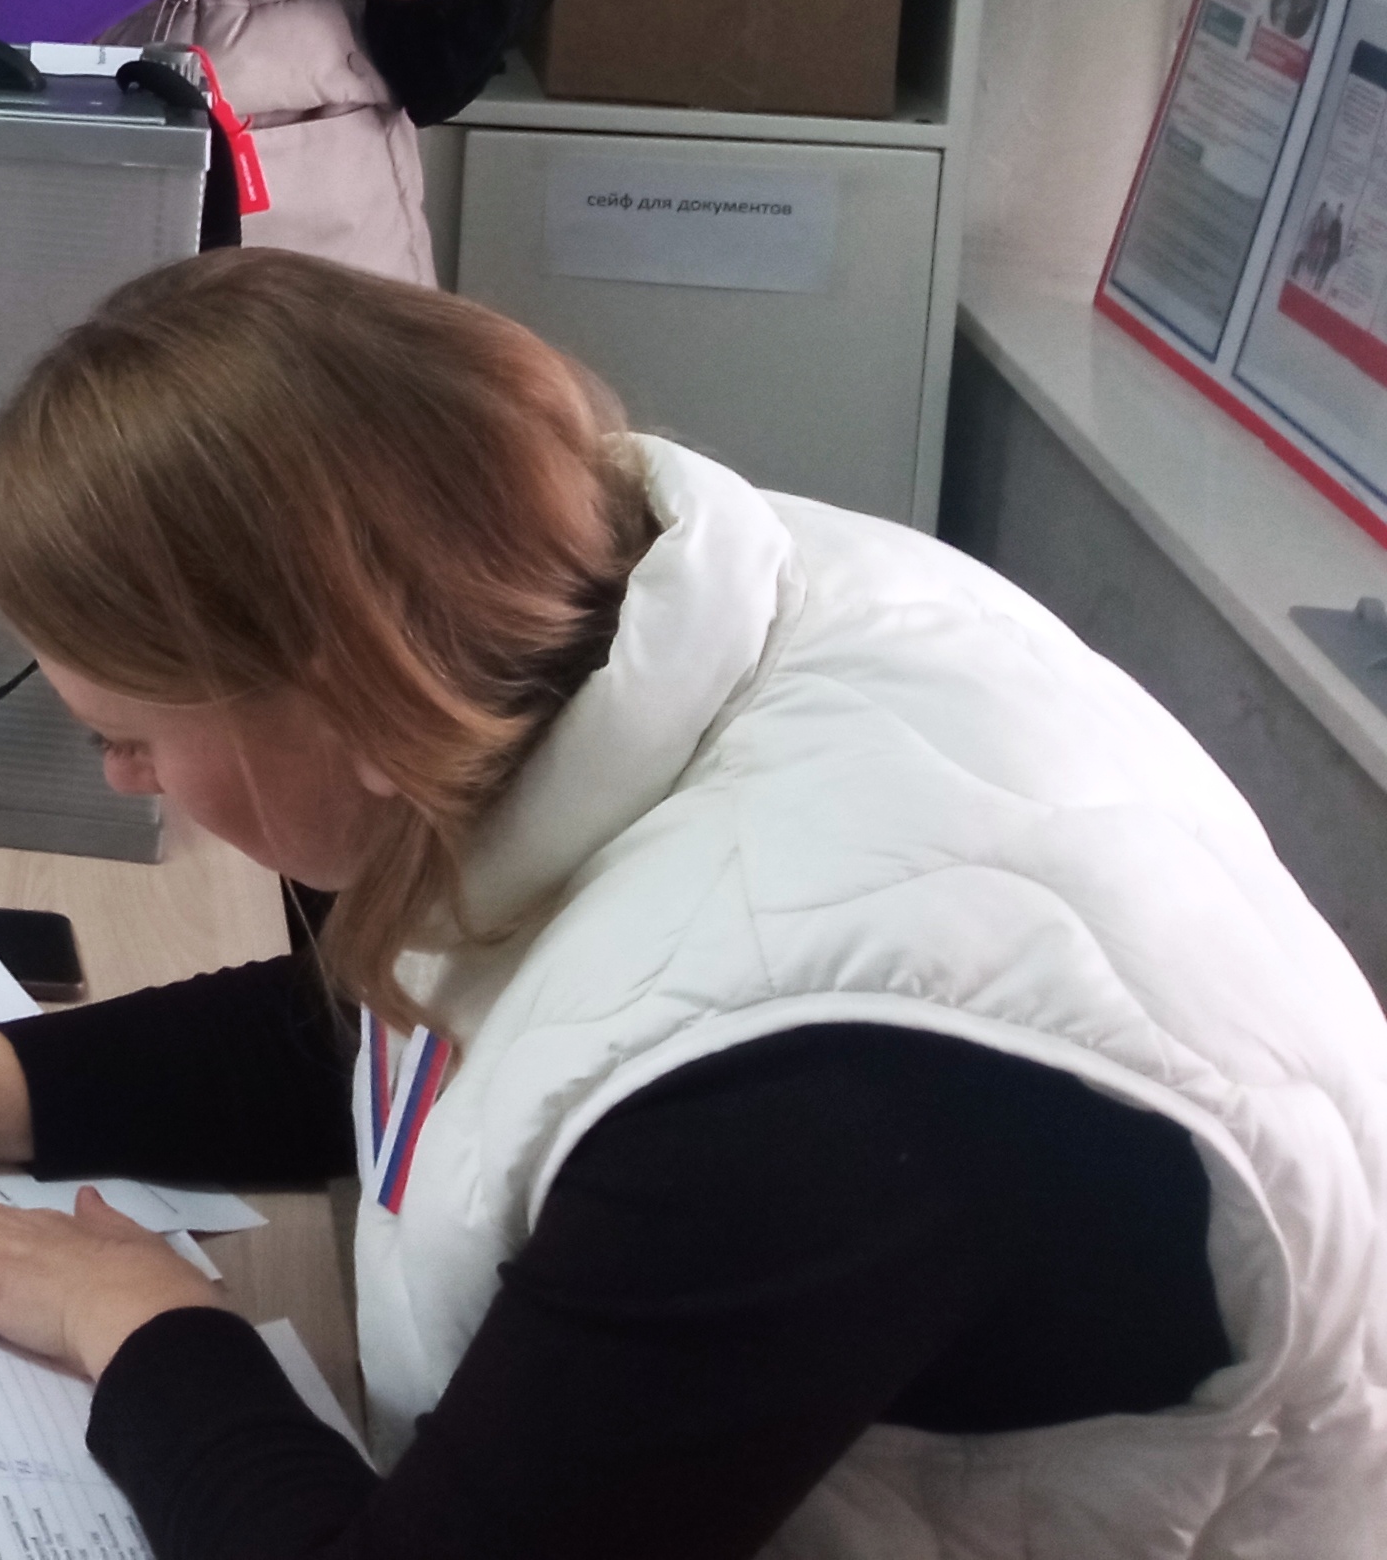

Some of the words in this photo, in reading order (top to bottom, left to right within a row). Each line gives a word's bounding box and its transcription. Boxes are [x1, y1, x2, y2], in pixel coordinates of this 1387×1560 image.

[587, 193, 633, 210] сейф
[637, 197, 672, 210] для
[677, 199, 792, 216] документов
